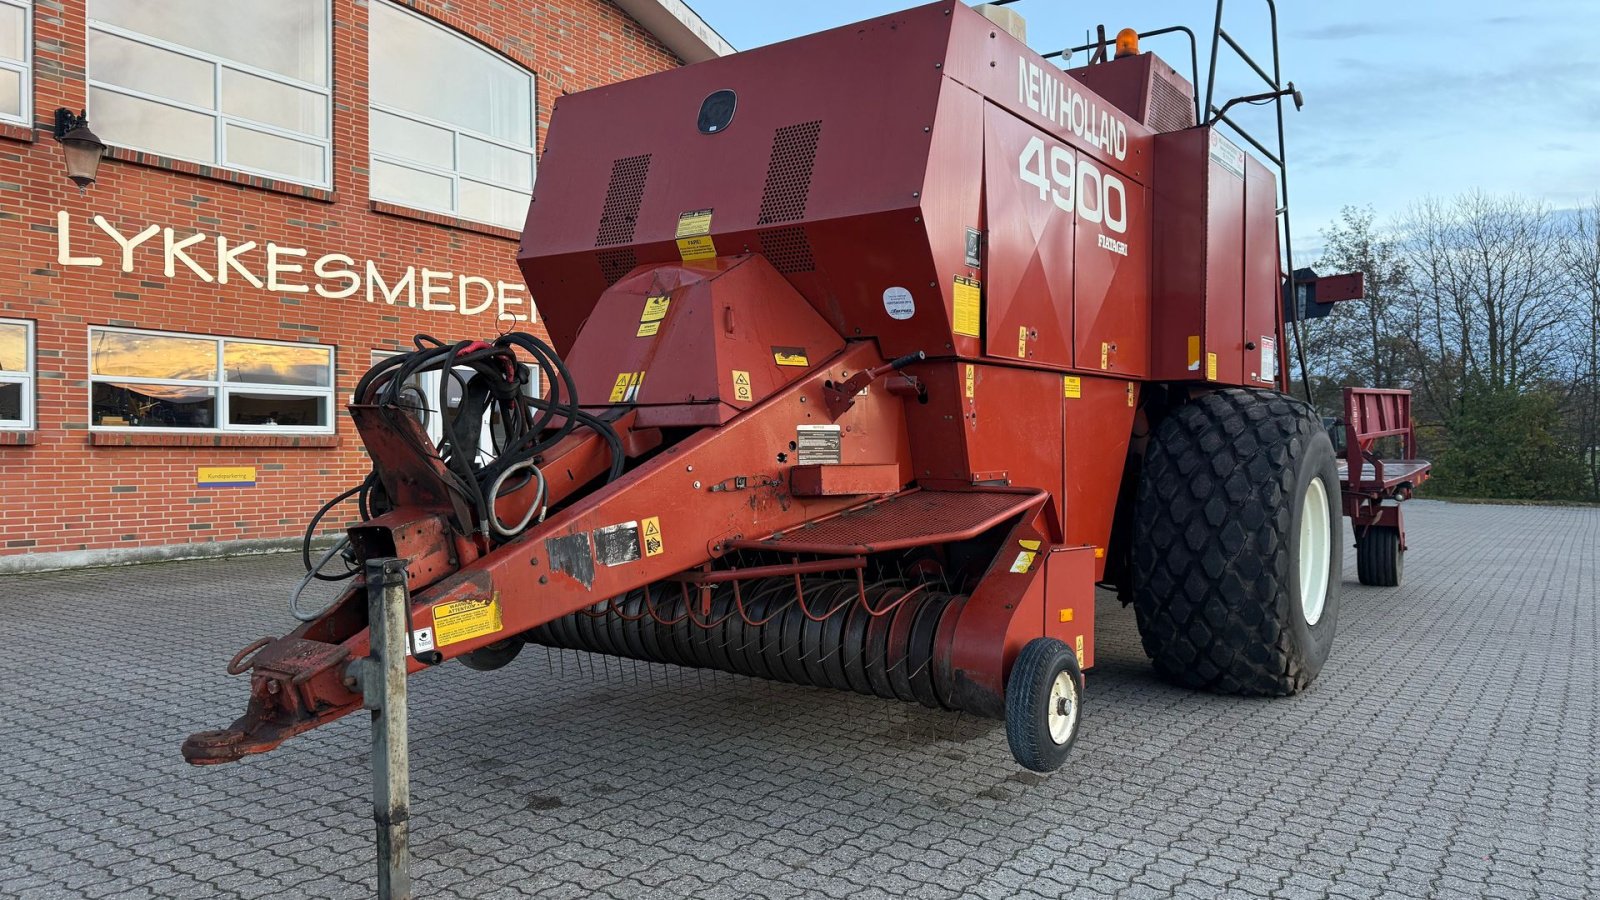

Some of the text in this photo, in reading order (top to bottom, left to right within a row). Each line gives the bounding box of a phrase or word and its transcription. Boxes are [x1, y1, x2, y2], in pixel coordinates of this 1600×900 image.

[1018, 55, 1127, 162] NEW HOLLAND
[1018, 135, 1127, 234] 4900
